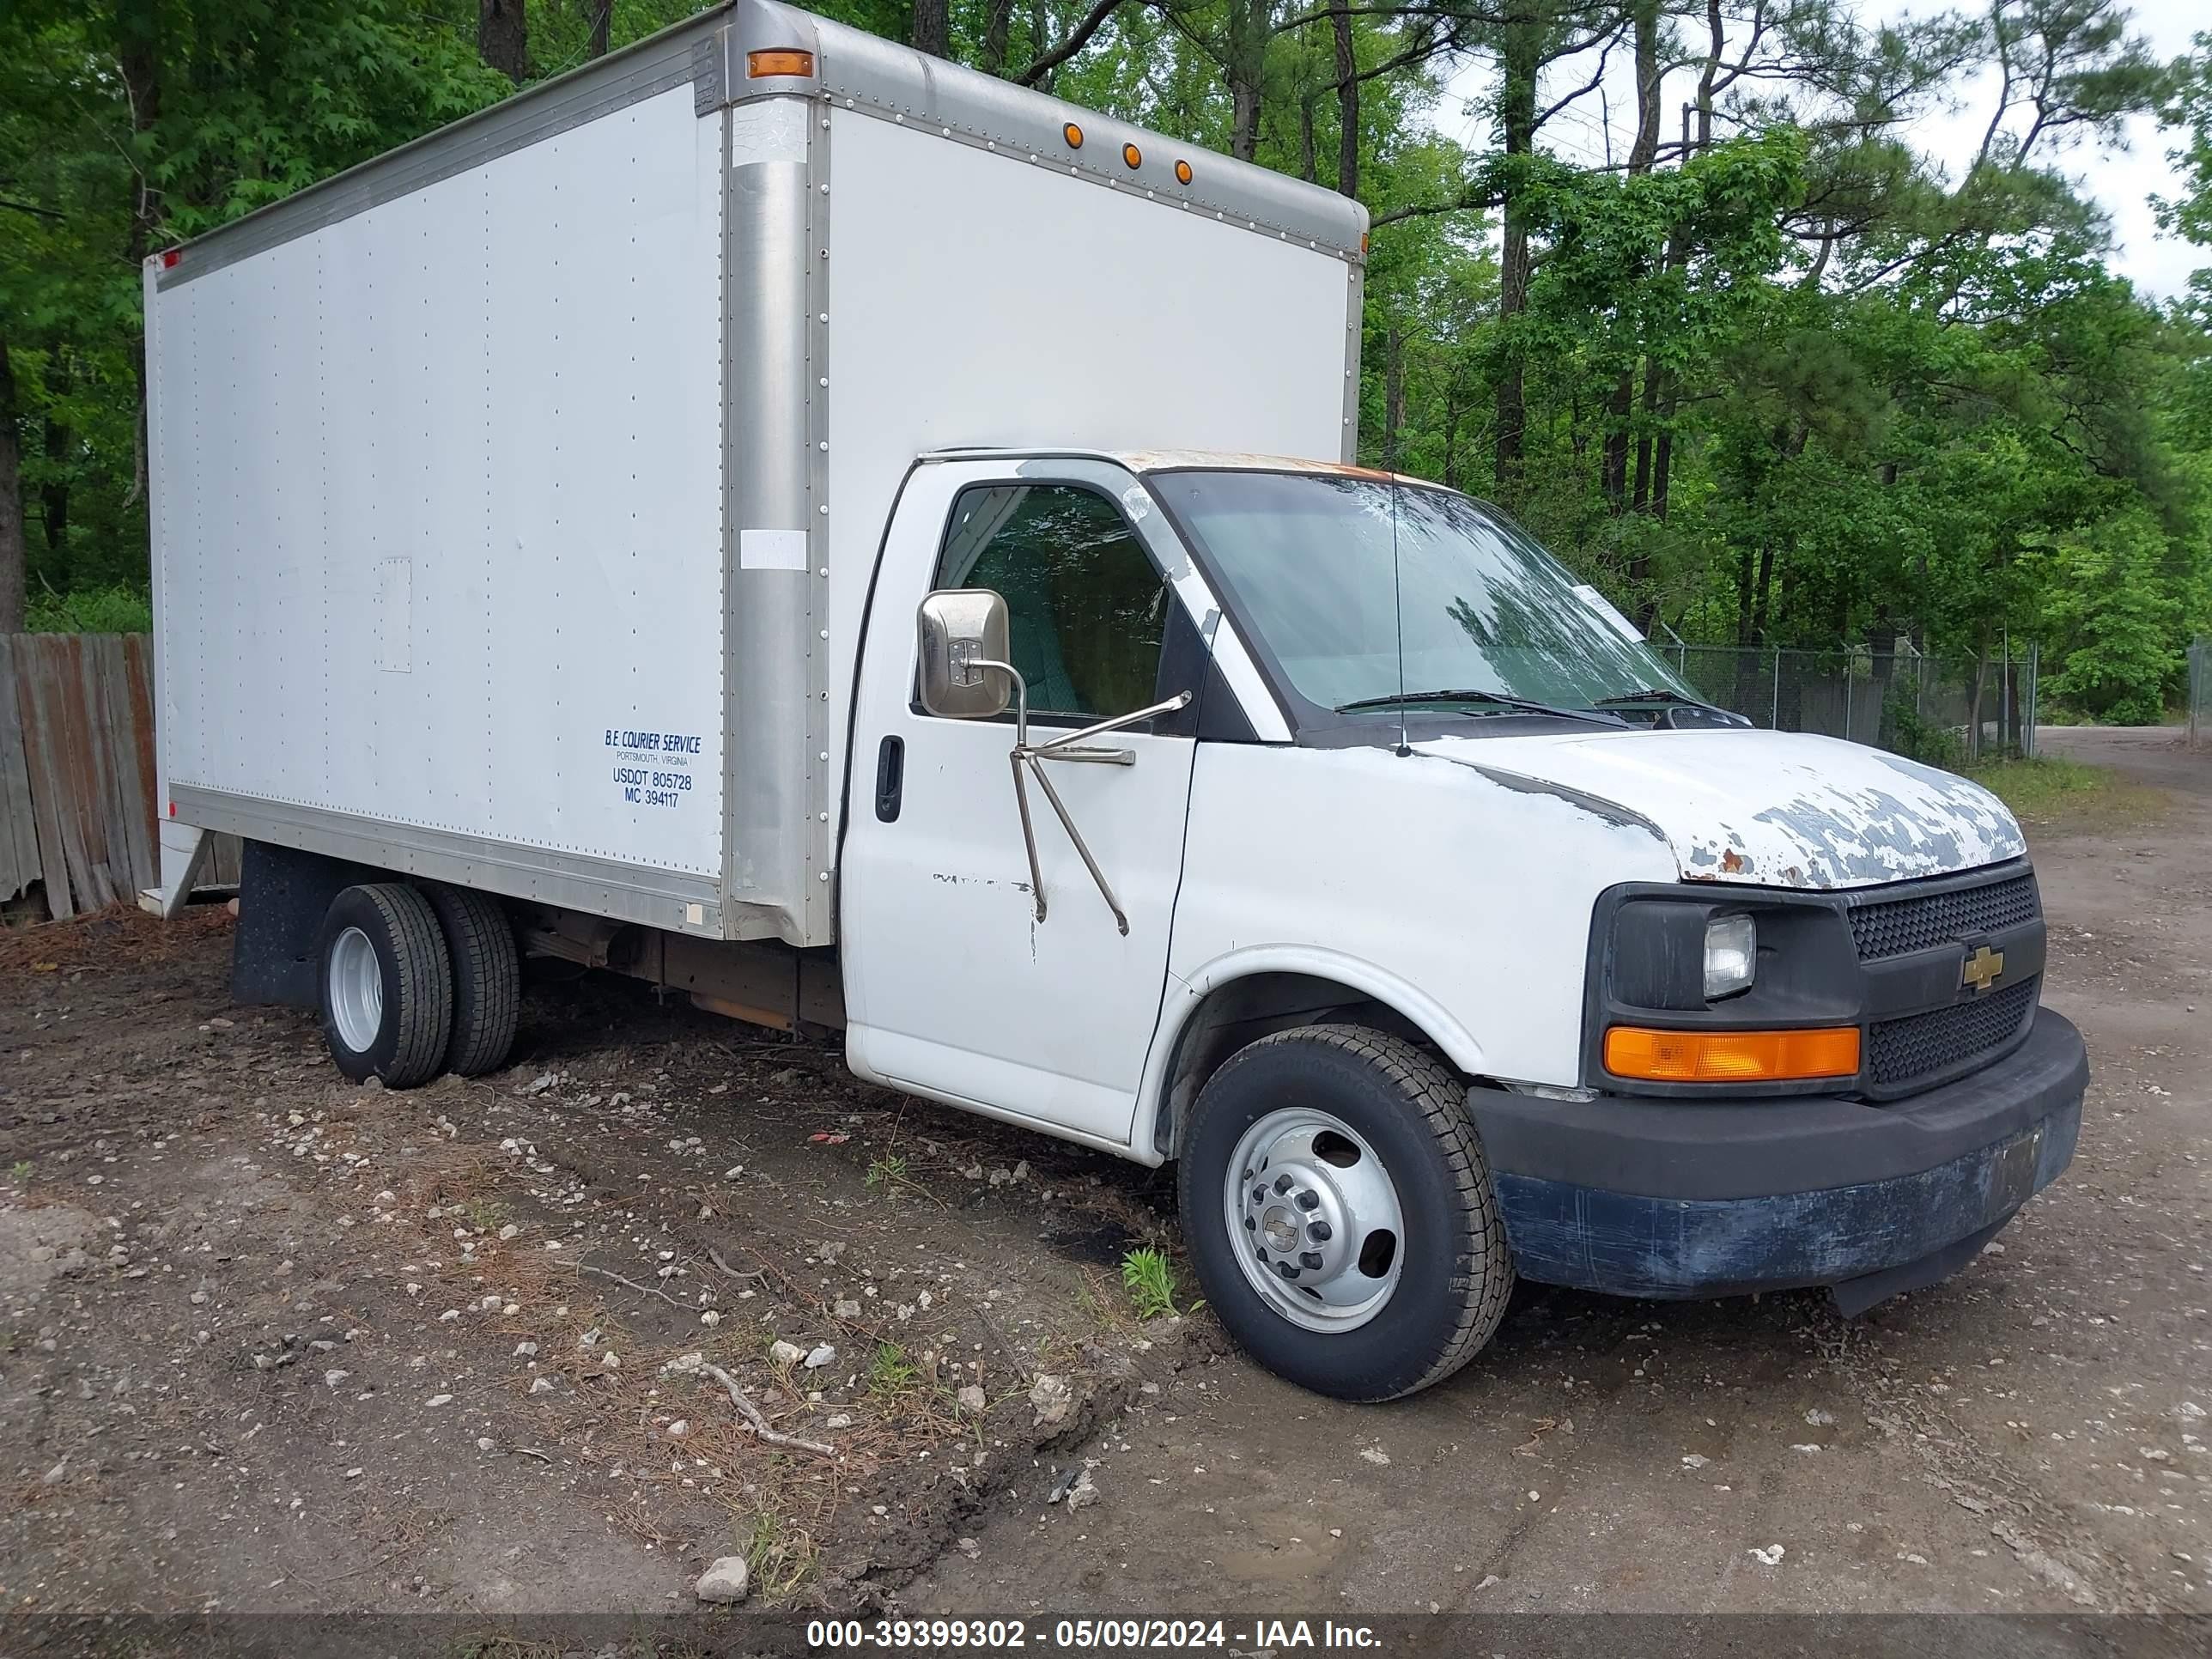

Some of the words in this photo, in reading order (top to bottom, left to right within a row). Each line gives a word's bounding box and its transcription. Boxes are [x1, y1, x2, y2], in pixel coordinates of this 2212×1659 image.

[622, 731, 660, 750] COURIER
[662, 734, 702, 754] SERVICE
[661, 755, 688, 767] VIRGINIA
[613, 767, 648, 786] USDOT
[653, 771, 692, 791] 805728
[625, 787, 641, 804] MC
[645, 789, 678, 808] 394117
